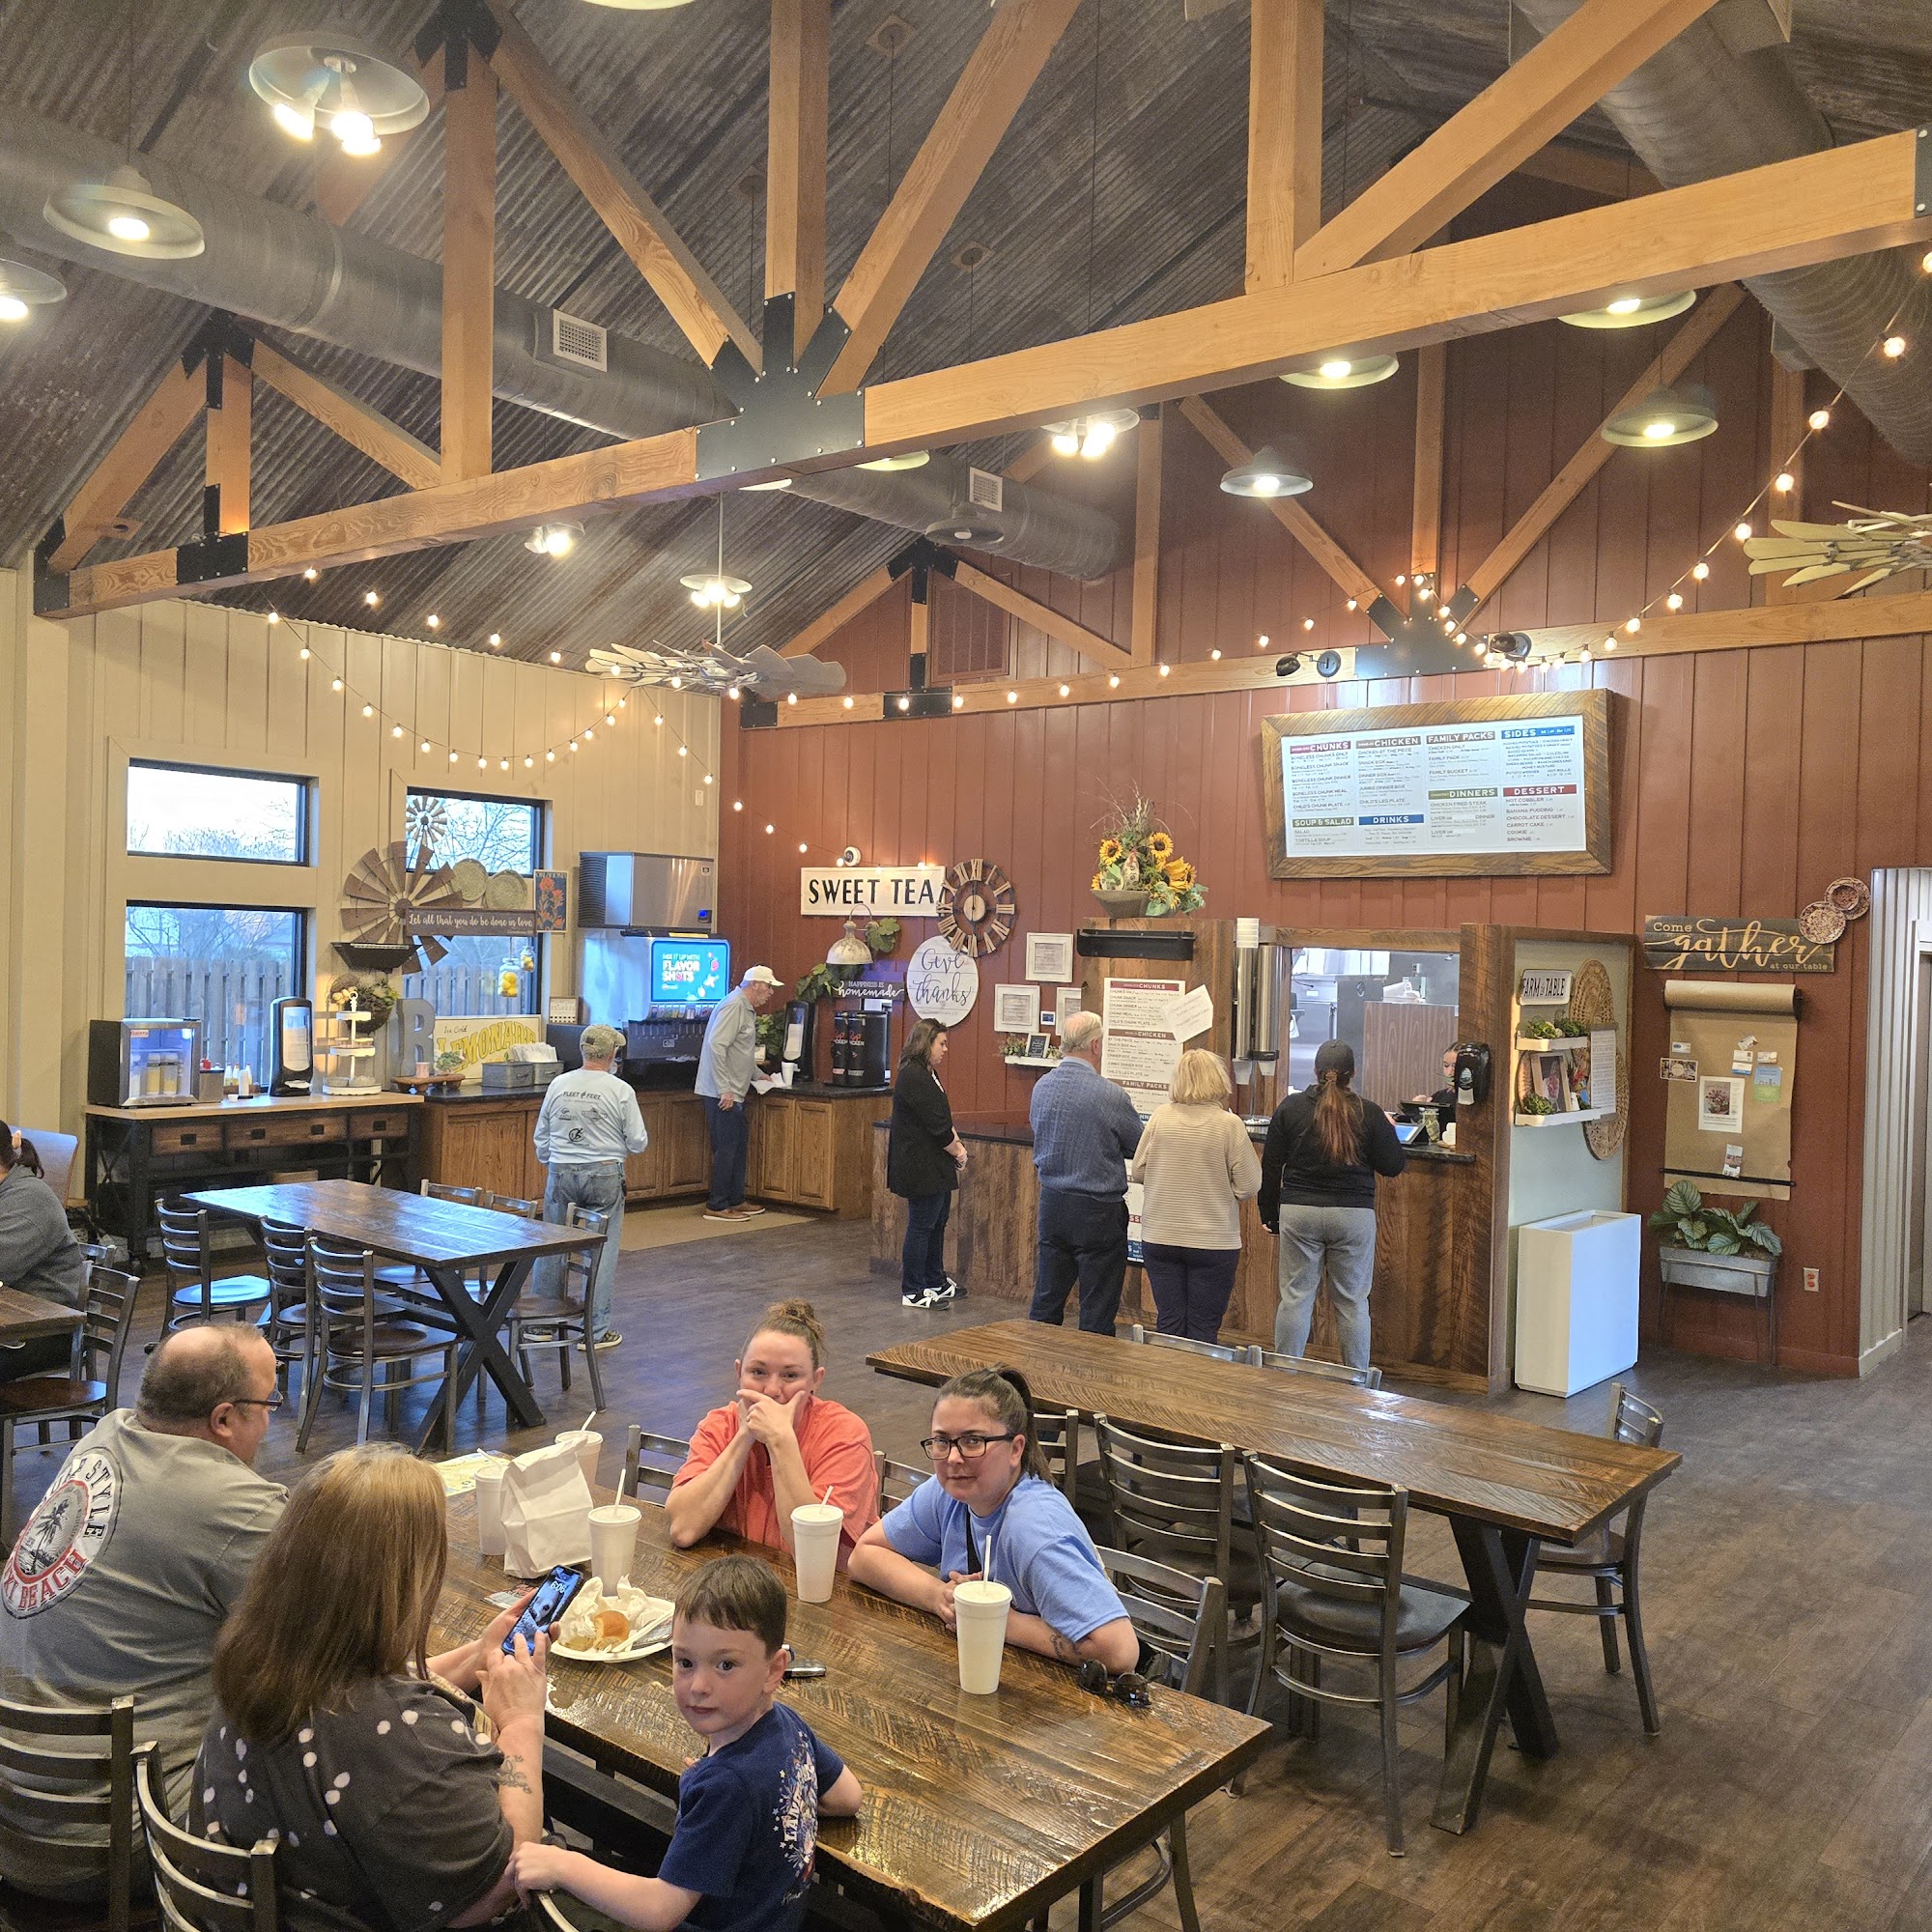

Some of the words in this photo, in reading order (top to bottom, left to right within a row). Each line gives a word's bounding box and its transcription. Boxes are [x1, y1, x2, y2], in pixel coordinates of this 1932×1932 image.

[1428, 734, 1460, 743] FAMILY
[1462, 732, 1493, 740] PACKS
[1504, 729, 1536, 738] SIDES
[1310, 741, 1349, 751] CHUNKS
[1375, 738, 1418, 746] CHICKEN
[1450, 789, 1495, 797] DINNERS
[1514, 787, 1564, 795] DESSERT
[809, 879, 880, 905] SWEET
[891, 879, 935, 904] TEA
[409, 914, 420, 924] Let
[423, 913, 435, 924] all
[436, 913, 454, 925] that
[454, 917, 468, 929] you
[469, 916, 479, 926] do
[480, 916, 489, 926] be
[490, 917, 507, 927] done
[508, 918, 516, 927] in
[1653, 922, 1692, 932] Come
[1645, 919, 1820, 969] gather
[662, 960, 700, 971] FLAVOR
[922, 948, 964, 974] Give
[832, 980, 904, 997] homemade
[913, 972, 971, 1006] thanks
[1545, 978, 1565, 996] TABLE
[454, 1025, 467, 1033] Cold
[84, 1459, 112, 1539] STYLE
[18, 1549, 89, 1610] BEACH
